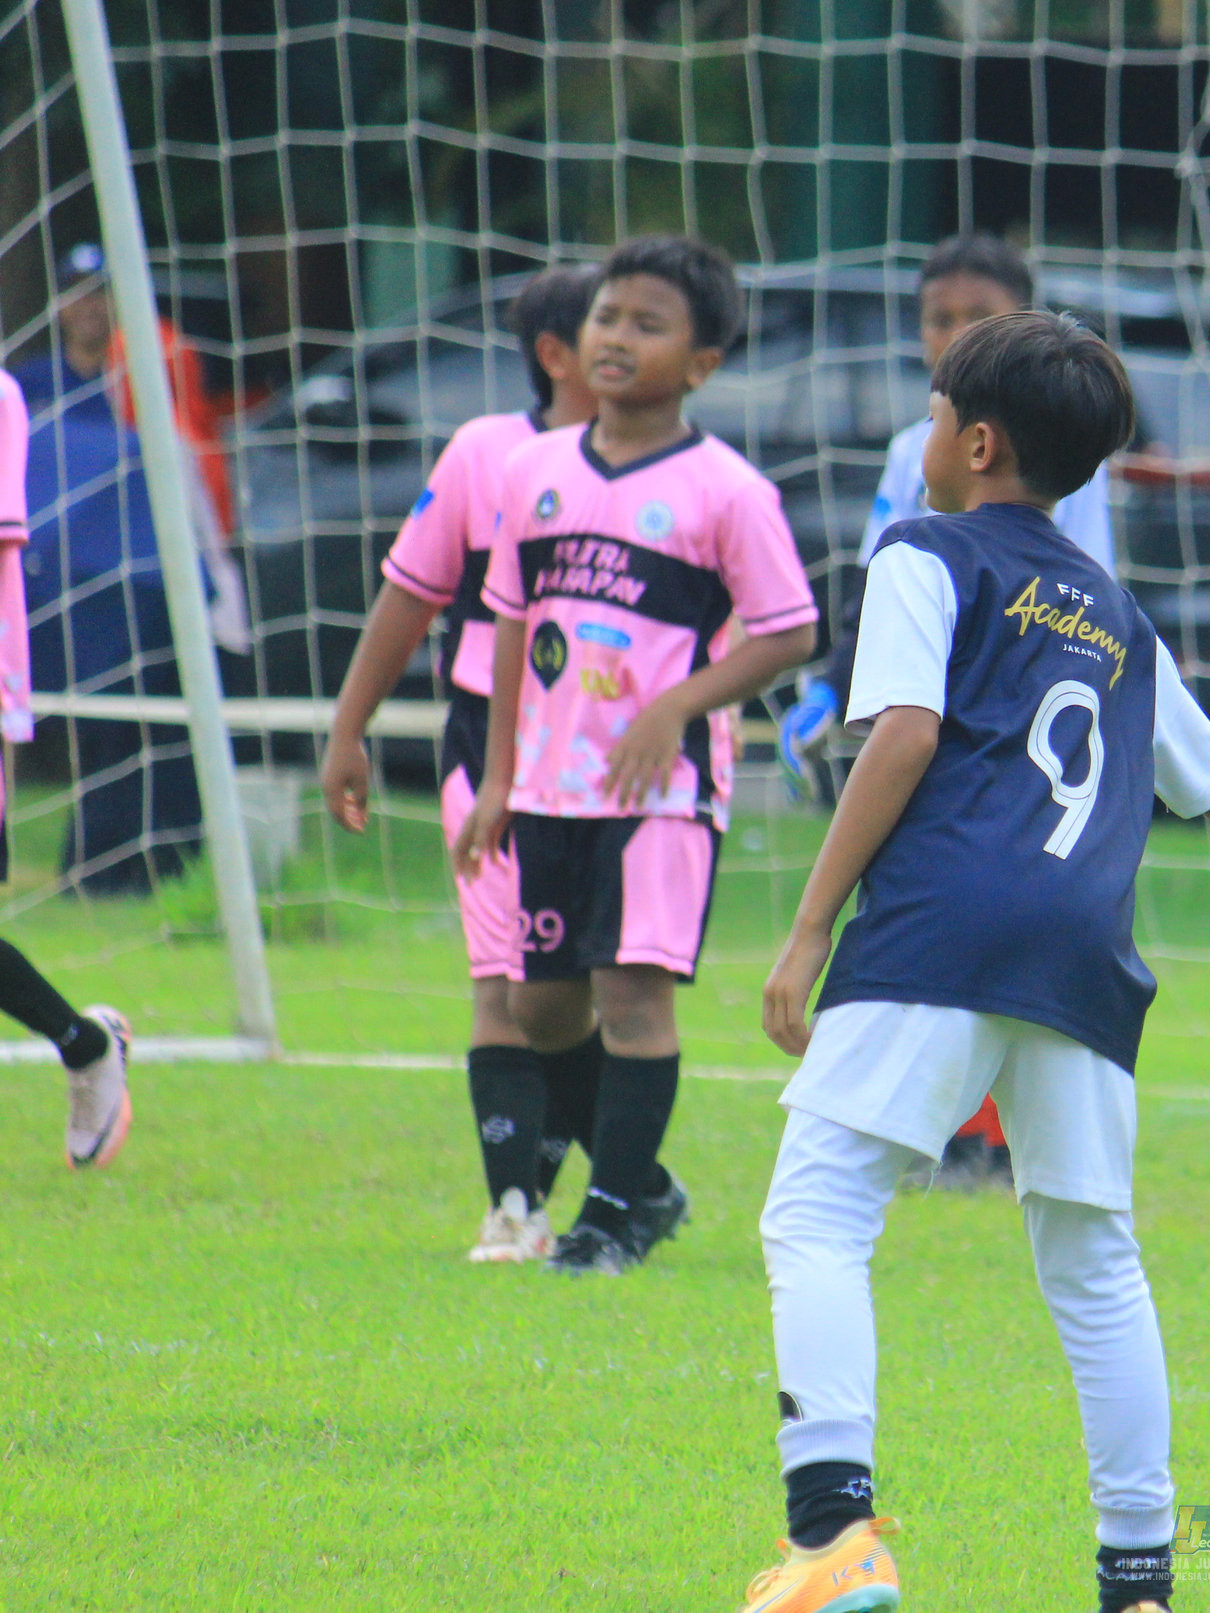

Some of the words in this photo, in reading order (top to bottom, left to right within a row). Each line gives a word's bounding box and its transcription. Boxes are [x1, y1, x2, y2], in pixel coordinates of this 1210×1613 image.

[1056, 582, 1094, 607] FFF
[1004, 576, 1127, 691] Academy
[1063, 643, 1102, 662] JAKARTA
[1027, 679, 1104, 860] 9
[513, 908, 565, 953] 29
